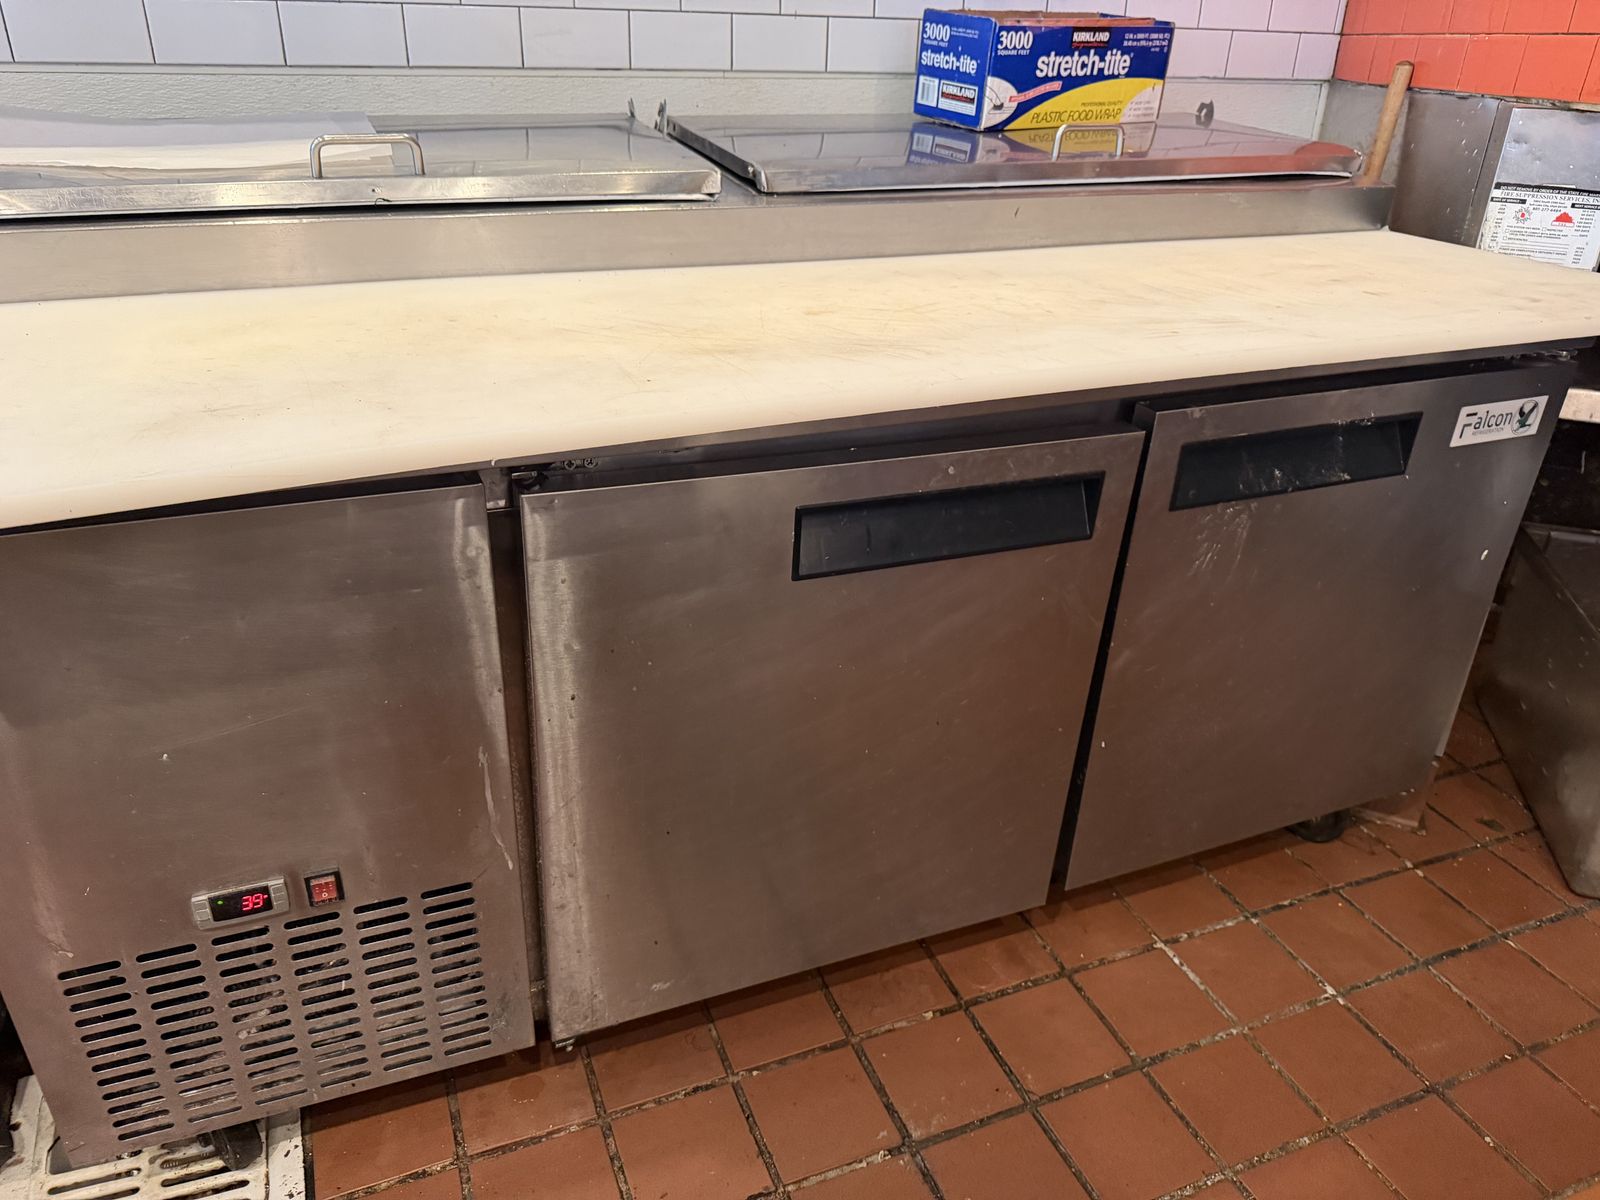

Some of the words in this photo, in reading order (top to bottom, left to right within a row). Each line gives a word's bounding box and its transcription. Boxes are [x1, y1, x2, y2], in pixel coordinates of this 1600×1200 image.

[923, 22, 950, 42] 3000
[998, 31, 1034, 49] 3000
[1073, 32, 1110, 43] KIRKLAND
[1017, 48, 1030, 56] FEET
[921, 49, 977, 74] stretch-tite
[1035, 50, 1130, 78] stretch-tite
[942, 84, 976, 99] KIRKLAND
[1030, 111, 1066, 124] PLASTIC
[1066, 110, 1095, 122] FOOD
[1095, 108, 1122, 120] WRAP
[1515, 192, 1558, 200] SUPPRESSION
[1459, 410, 1513, 439] Falcon
